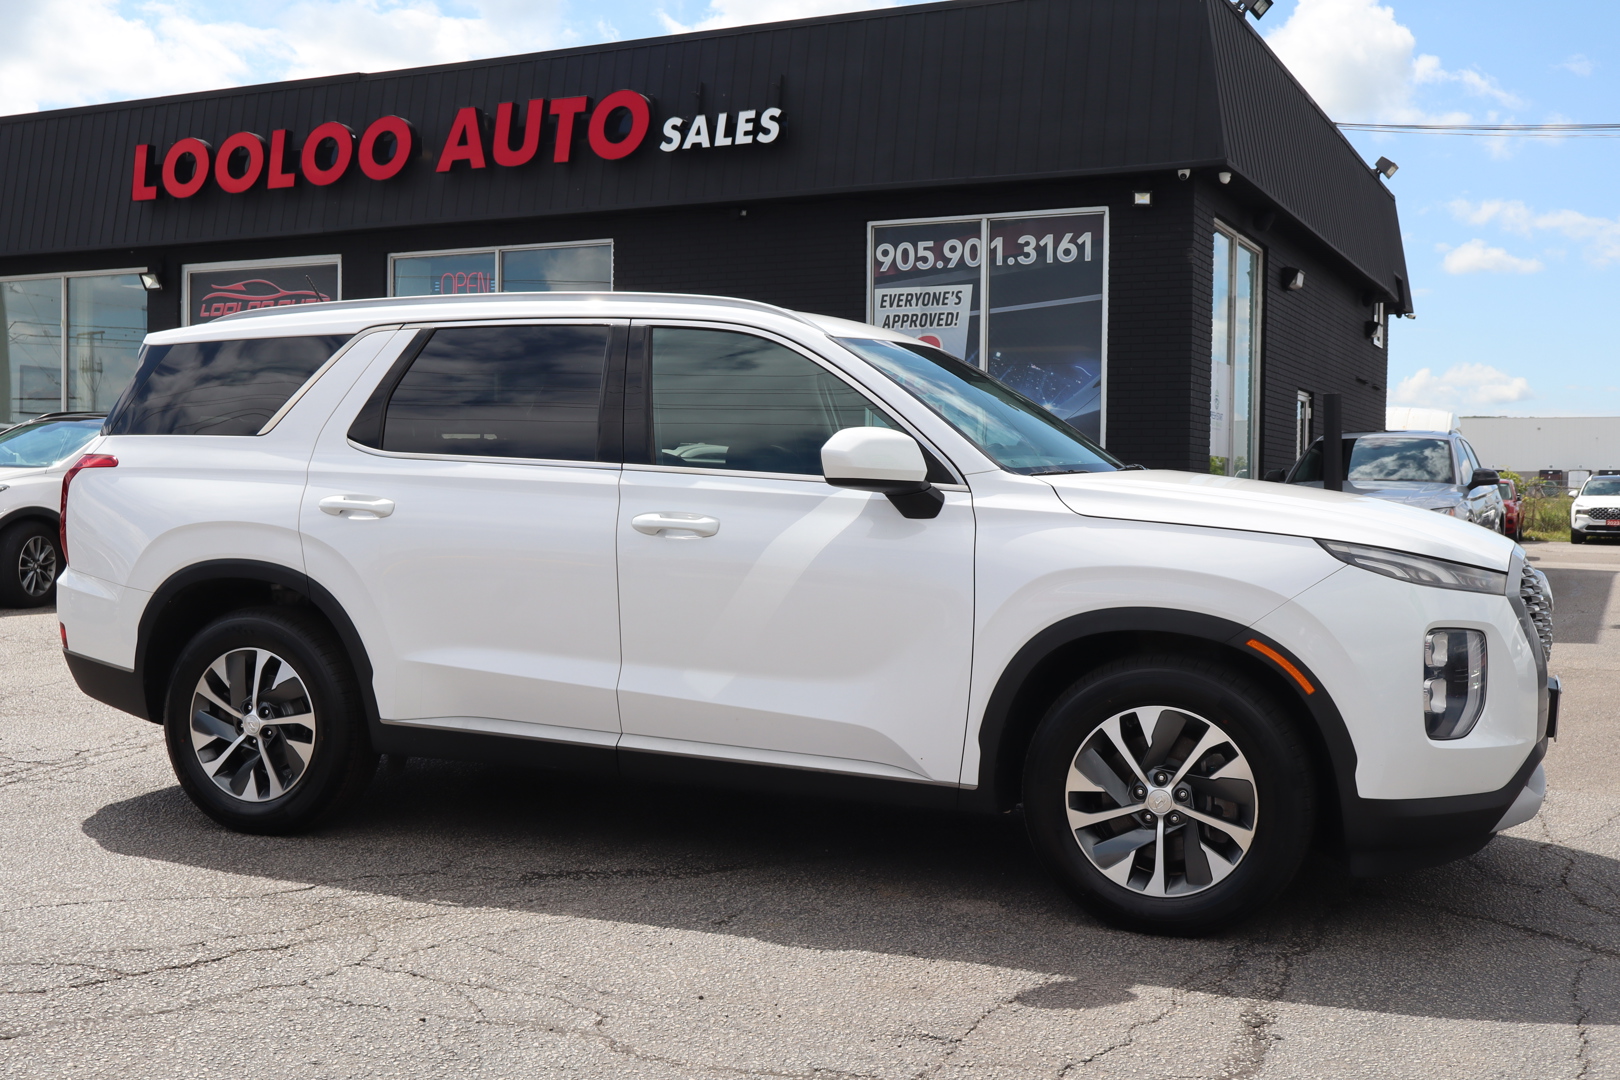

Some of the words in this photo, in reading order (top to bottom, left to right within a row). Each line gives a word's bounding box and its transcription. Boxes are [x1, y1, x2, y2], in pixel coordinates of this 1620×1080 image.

[131, 115, 414, 201] LOOLOO
[435, 89, 650, 173] AUTO
[660, 107, 783, 152] SALES
[875, 231, 1093, 272] 905.901.3161
[441, 272, 490, 294] OPEN
[879, 290, 963, 310] EVERYONE'S
[882, 311, 960, 329] APPROVED!
